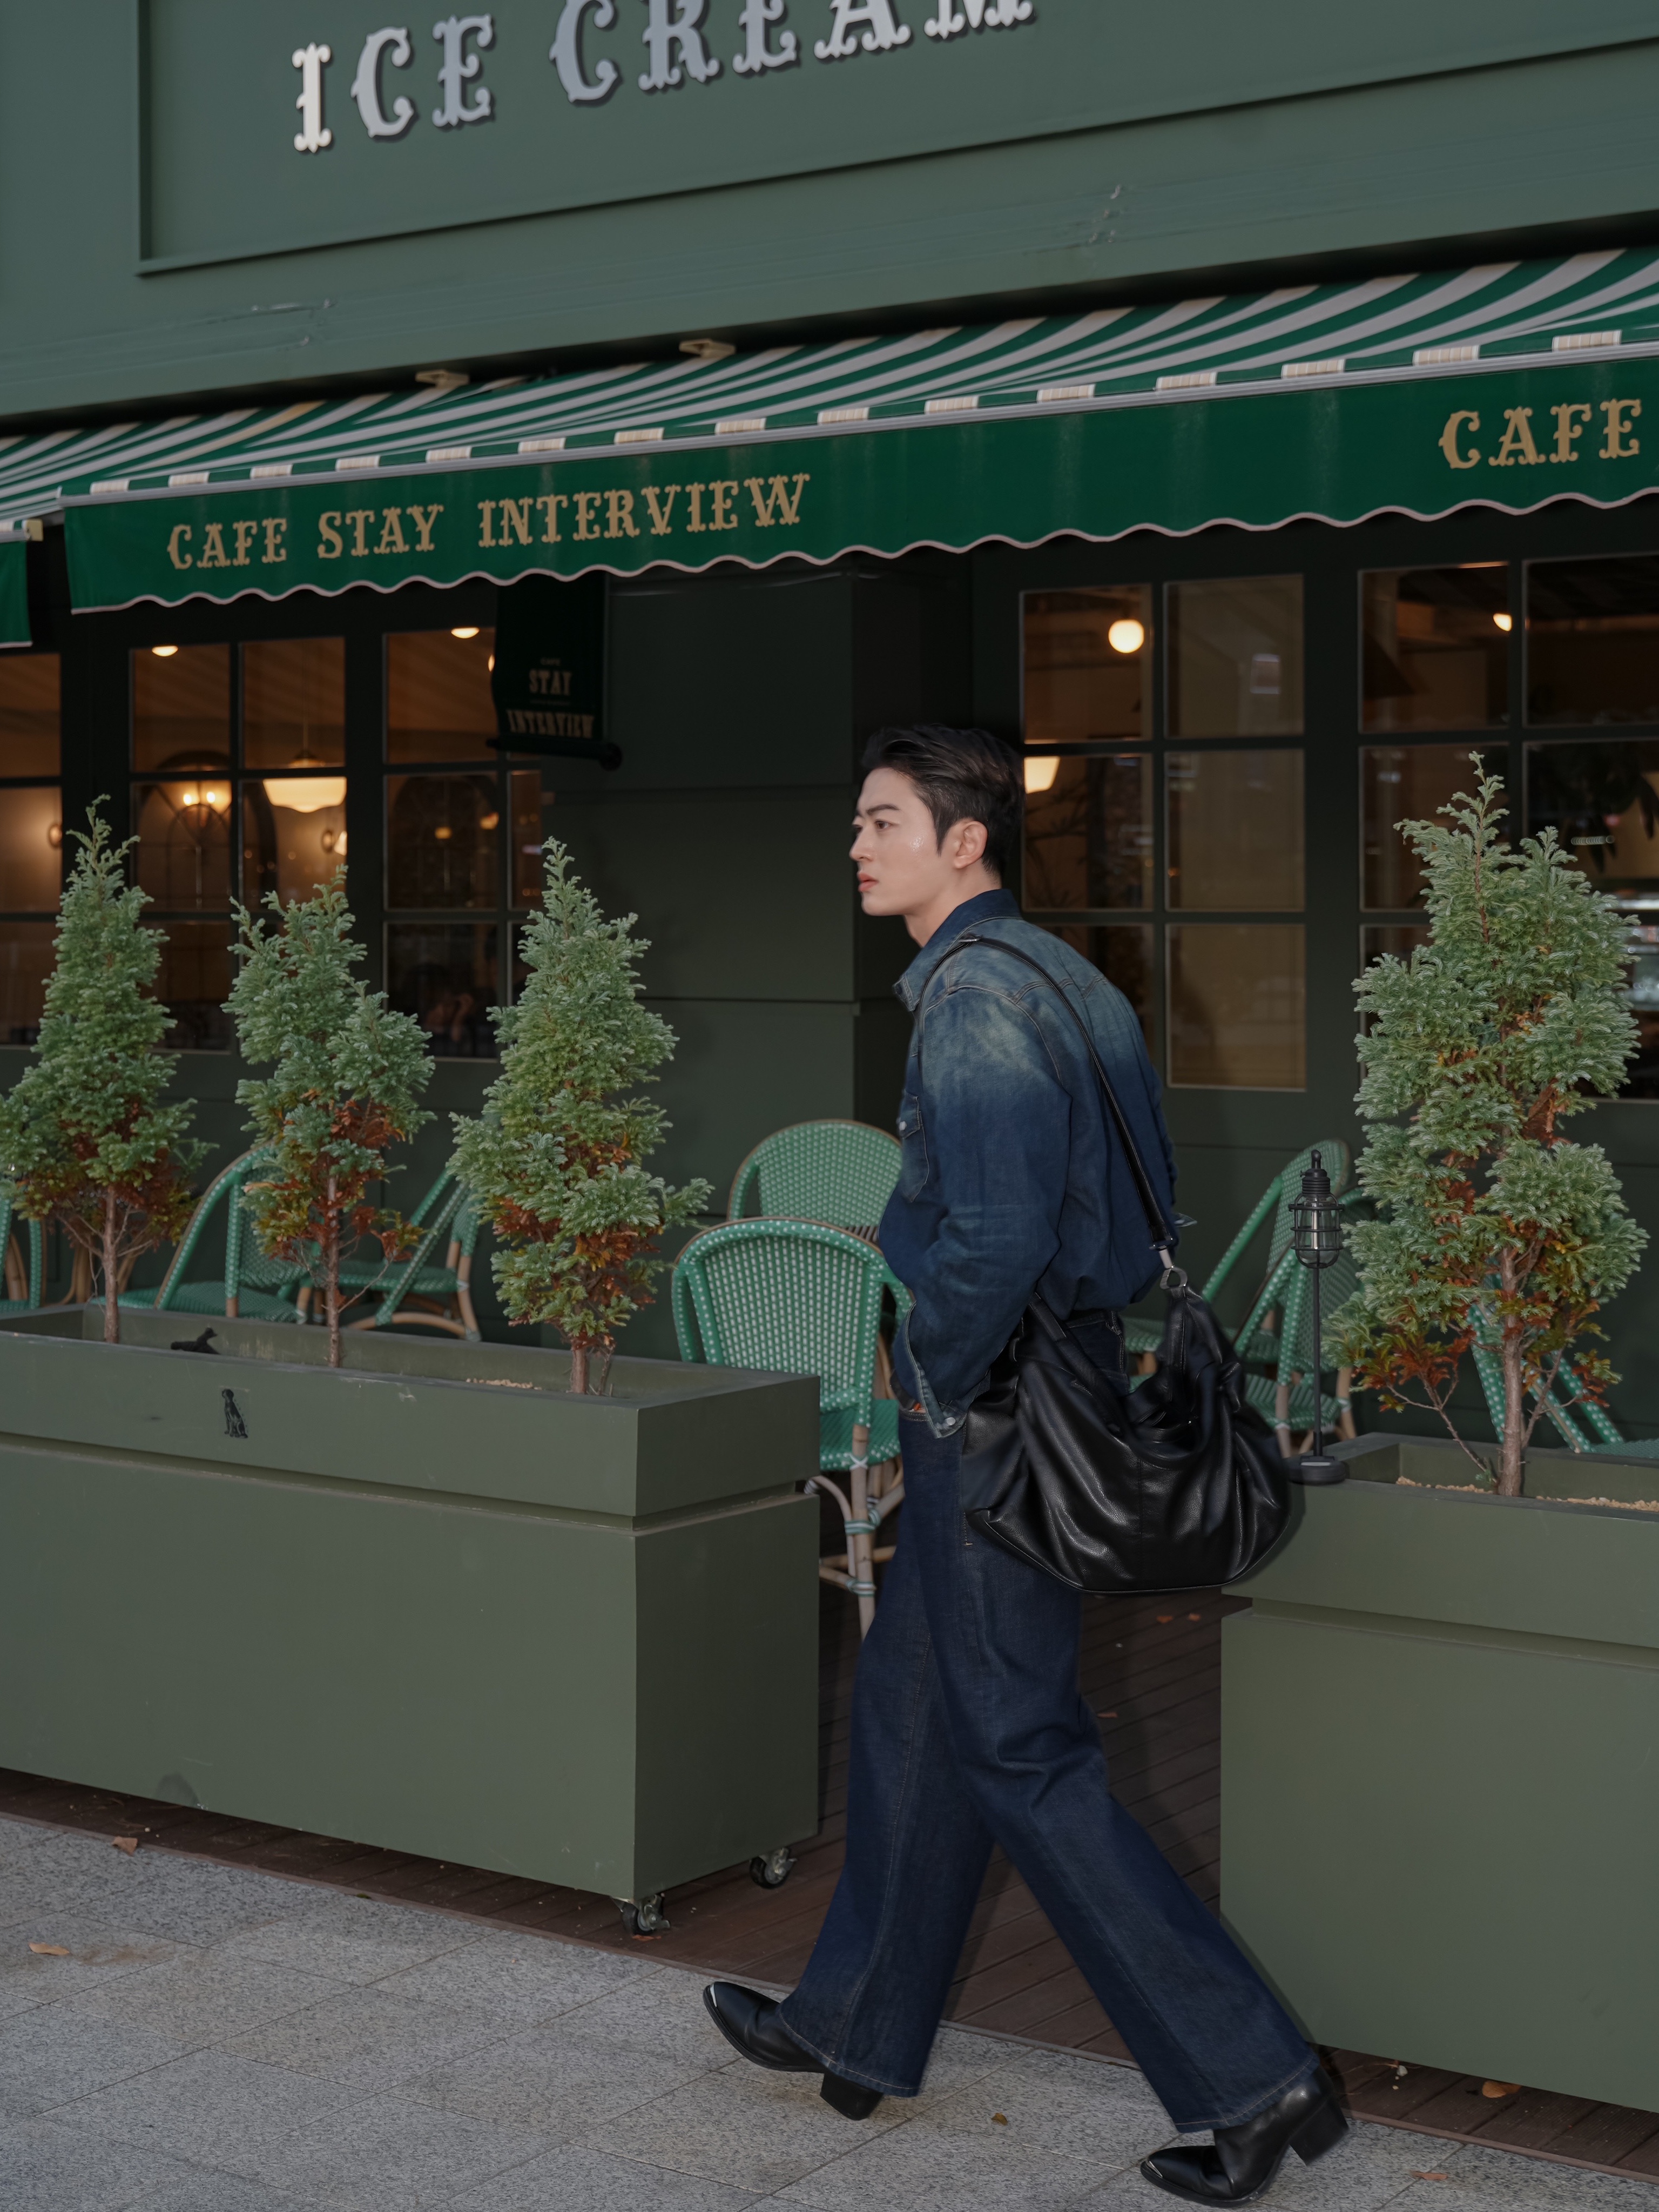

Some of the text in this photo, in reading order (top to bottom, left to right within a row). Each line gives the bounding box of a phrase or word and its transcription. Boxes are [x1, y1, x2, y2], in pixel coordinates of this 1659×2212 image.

[292, 14, 493, 153] ICE
[1439, 399, 1642, 469] CAFE
[167, 473, 811, 569] CAFE STAY INTERVIEW
[529, 669, 572, 696] STAY
[506, 709, 595, 739] INTERVIEW
